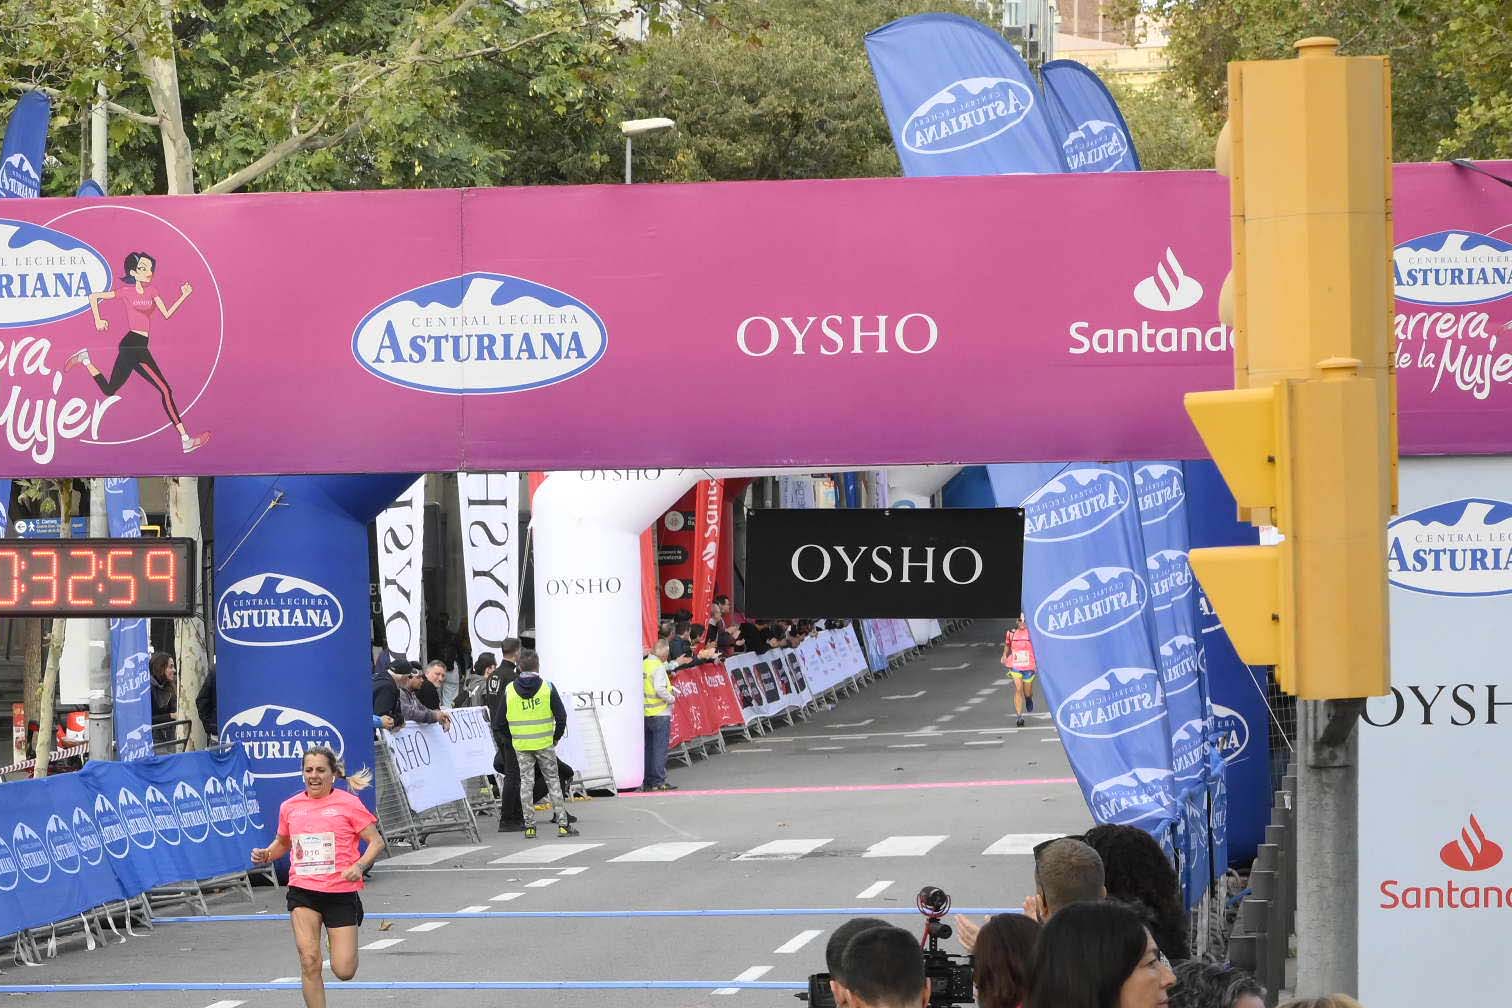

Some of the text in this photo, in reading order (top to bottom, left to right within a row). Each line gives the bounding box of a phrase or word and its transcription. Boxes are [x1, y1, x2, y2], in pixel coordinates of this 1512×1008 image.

[14, 254, 88, 267] LECHERA
[1408, 255, 1512, 266] CENTRAL LECHER
[411, 312, 580, 329] CENTRAL LECHERA
[1394, 311, 1490, 340] arrera
[372, 320, 588, 364] ASTURIANA
[736, 313, 940, 357] OYSHO
[1068, 320, 1236, 354] Santand
[1417, 341, 1436, 369] la
[1431, 336, 1512, 400] Muje
[1415, 533, 1484, 544] CENTRAL
[790, 543, 984, 585] OYSHO
[546, 576, 622, 596] OYSHO
[233, 597, 330, 607] CENTRAL LECHERA
[220, 604, 334, 630] ASTURIANA
[522, 698, 542, 712] Life
[576, 690, 624, 707] SHO
[1361, 683, 1512, 728] OYSH
[235, 729, 330, 738] CENTRAL LECHERA
